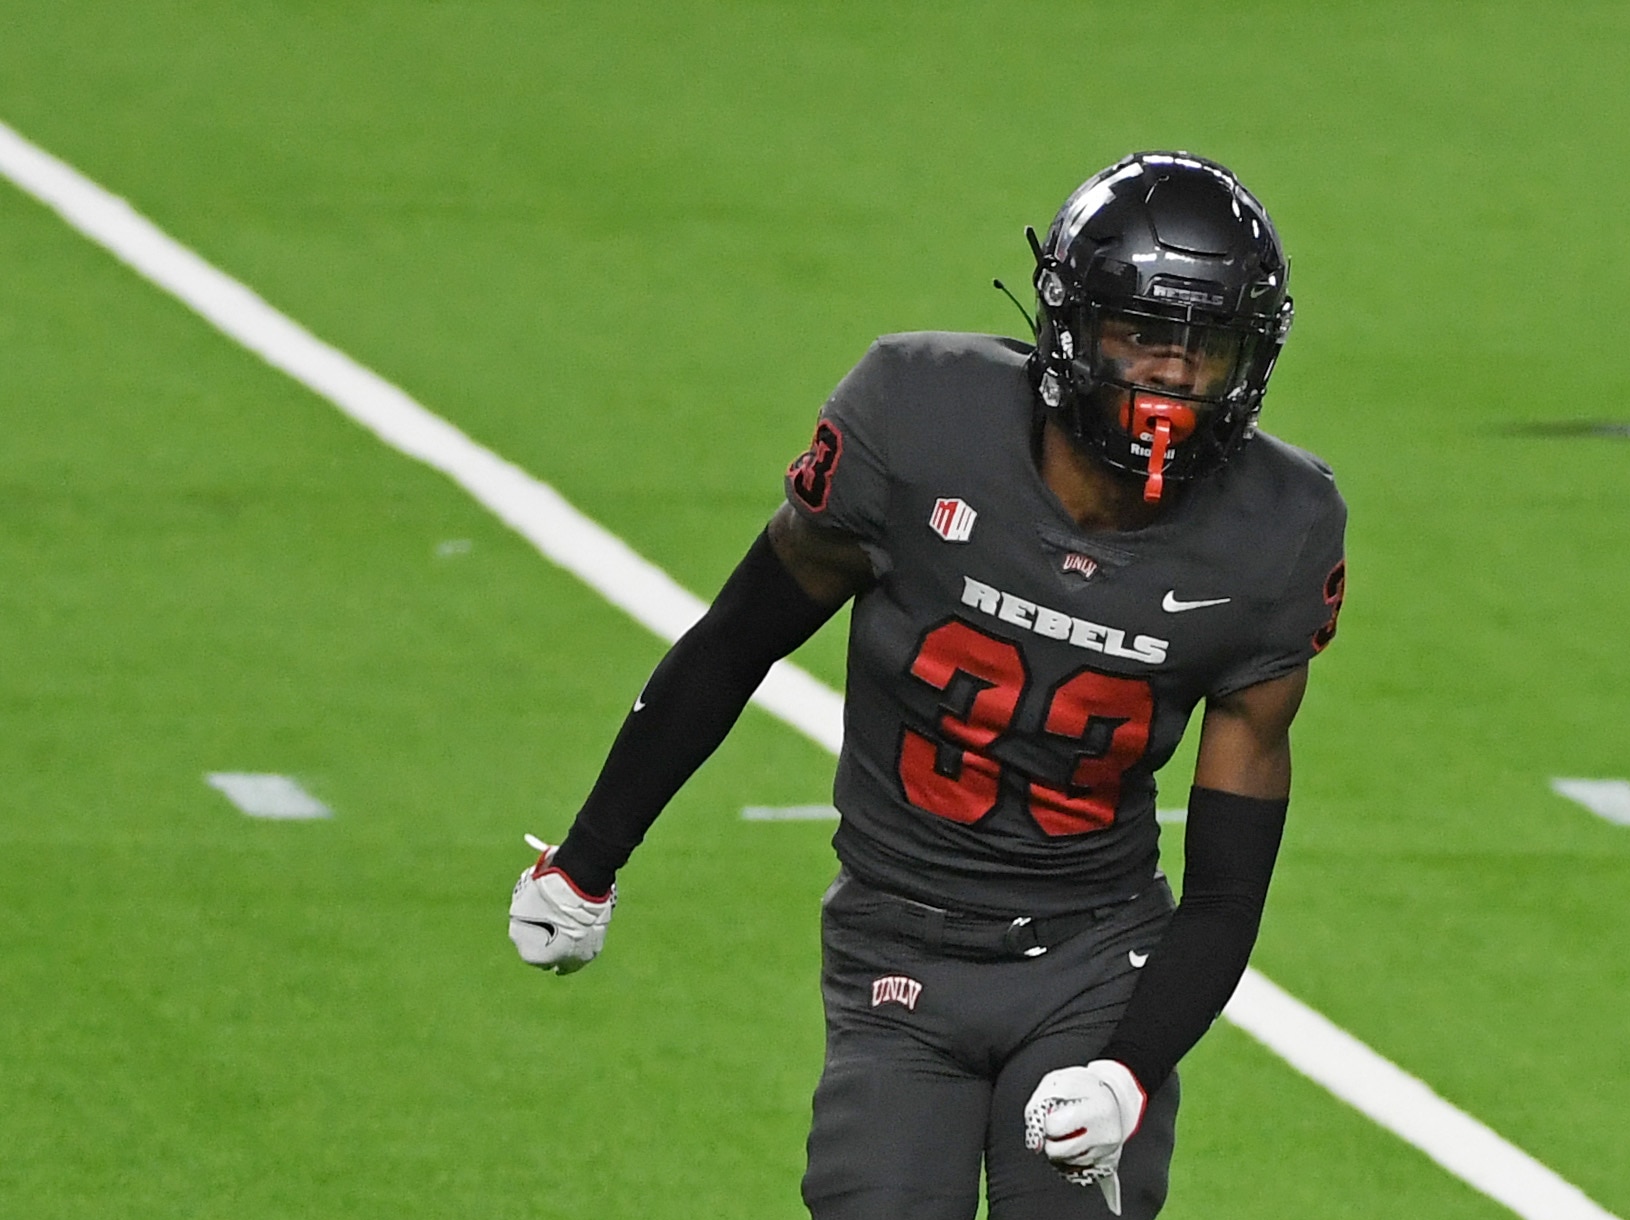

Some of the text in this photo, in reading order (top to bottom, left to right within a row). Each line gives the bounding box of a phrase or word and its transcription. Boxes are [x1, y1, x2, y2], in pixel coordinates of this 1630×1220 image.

[1062, 553, 1098, 578] UNLV
[961, 575, 1170, 664] REBELS
[898, 615, 1156, 838] 33
[872, 976, 923, 1010] UNLV
